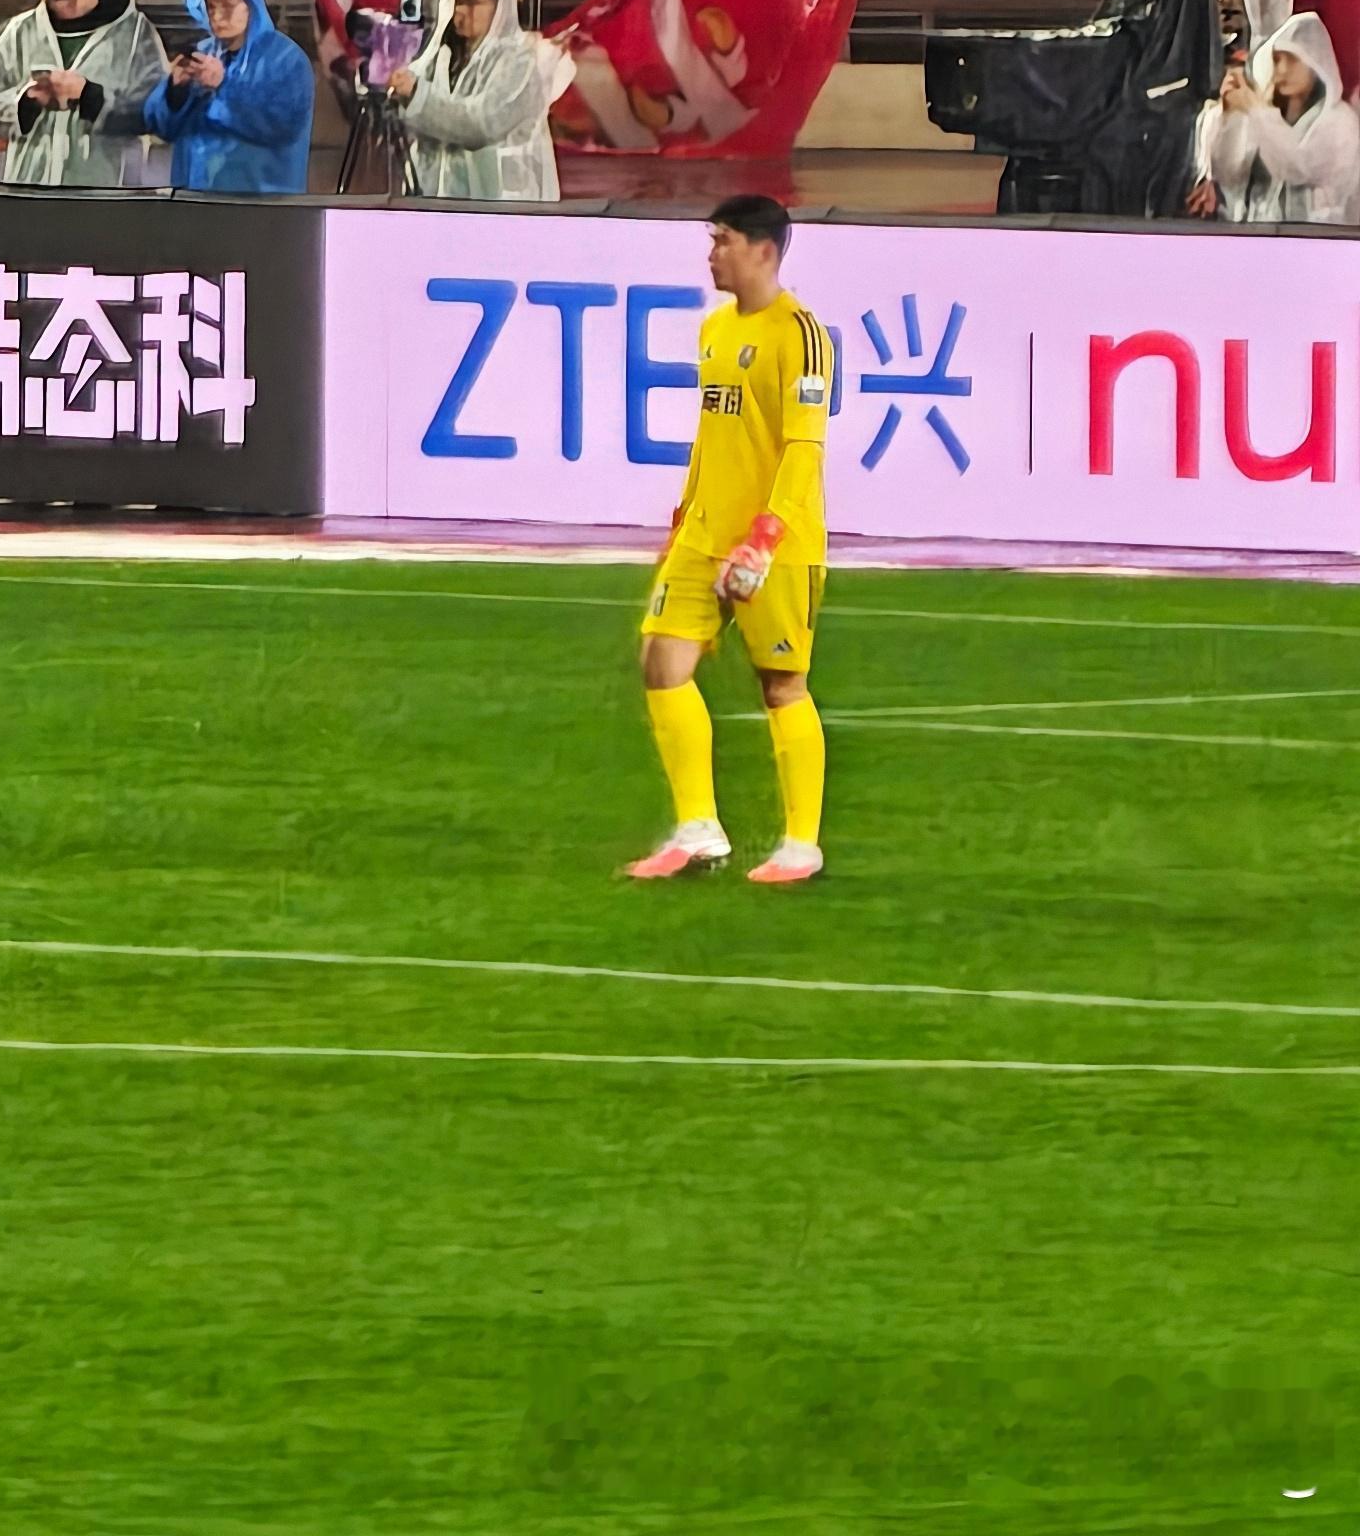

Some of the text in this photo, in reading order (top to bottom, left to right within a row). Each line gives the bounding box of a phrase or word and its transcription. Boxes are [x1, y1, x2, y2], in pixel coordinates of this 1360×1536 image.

[421, 277, 1360, 483] ZTE 兴 nu
